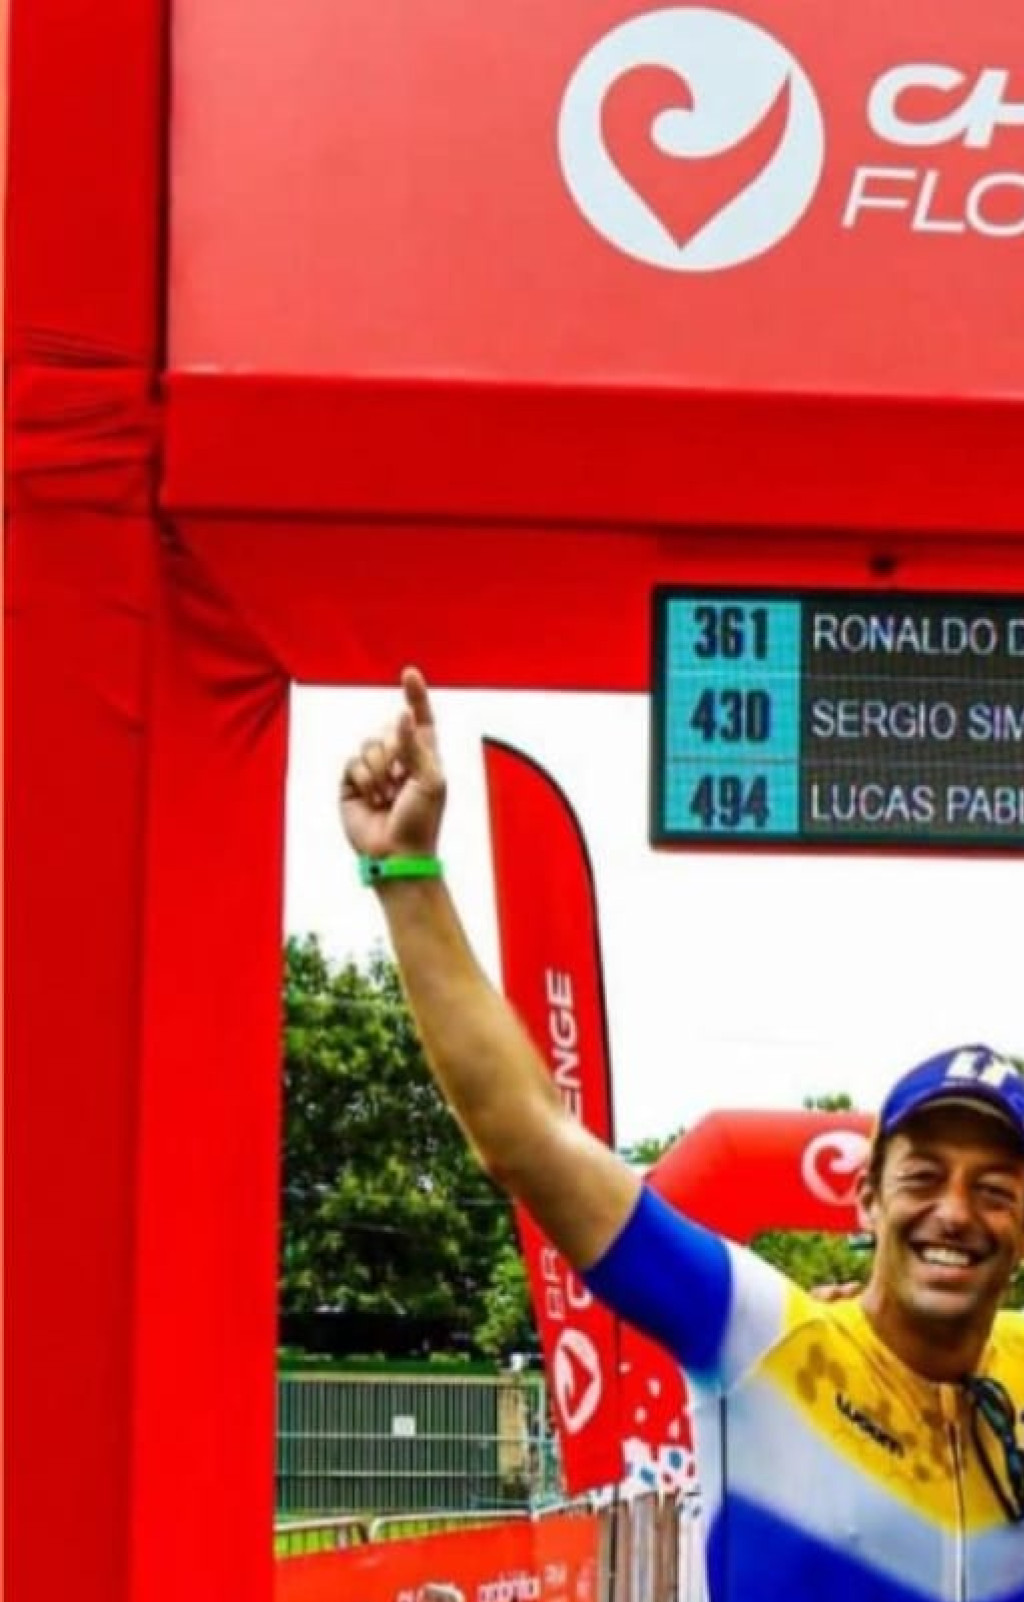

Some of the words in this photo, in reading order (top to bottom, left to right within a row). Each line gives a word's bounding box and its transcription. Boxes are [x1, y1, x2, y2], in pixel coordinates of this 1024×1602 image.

[692, 606, 769, 661] 361
[812, 613, 998, 658] RONALDO
[690, 690, 771, 743] 430
[811, 700, 955, 741] SERGIO
[687, 774, 770, 829] 494
[811, 783, 937, 824] LUCAS
